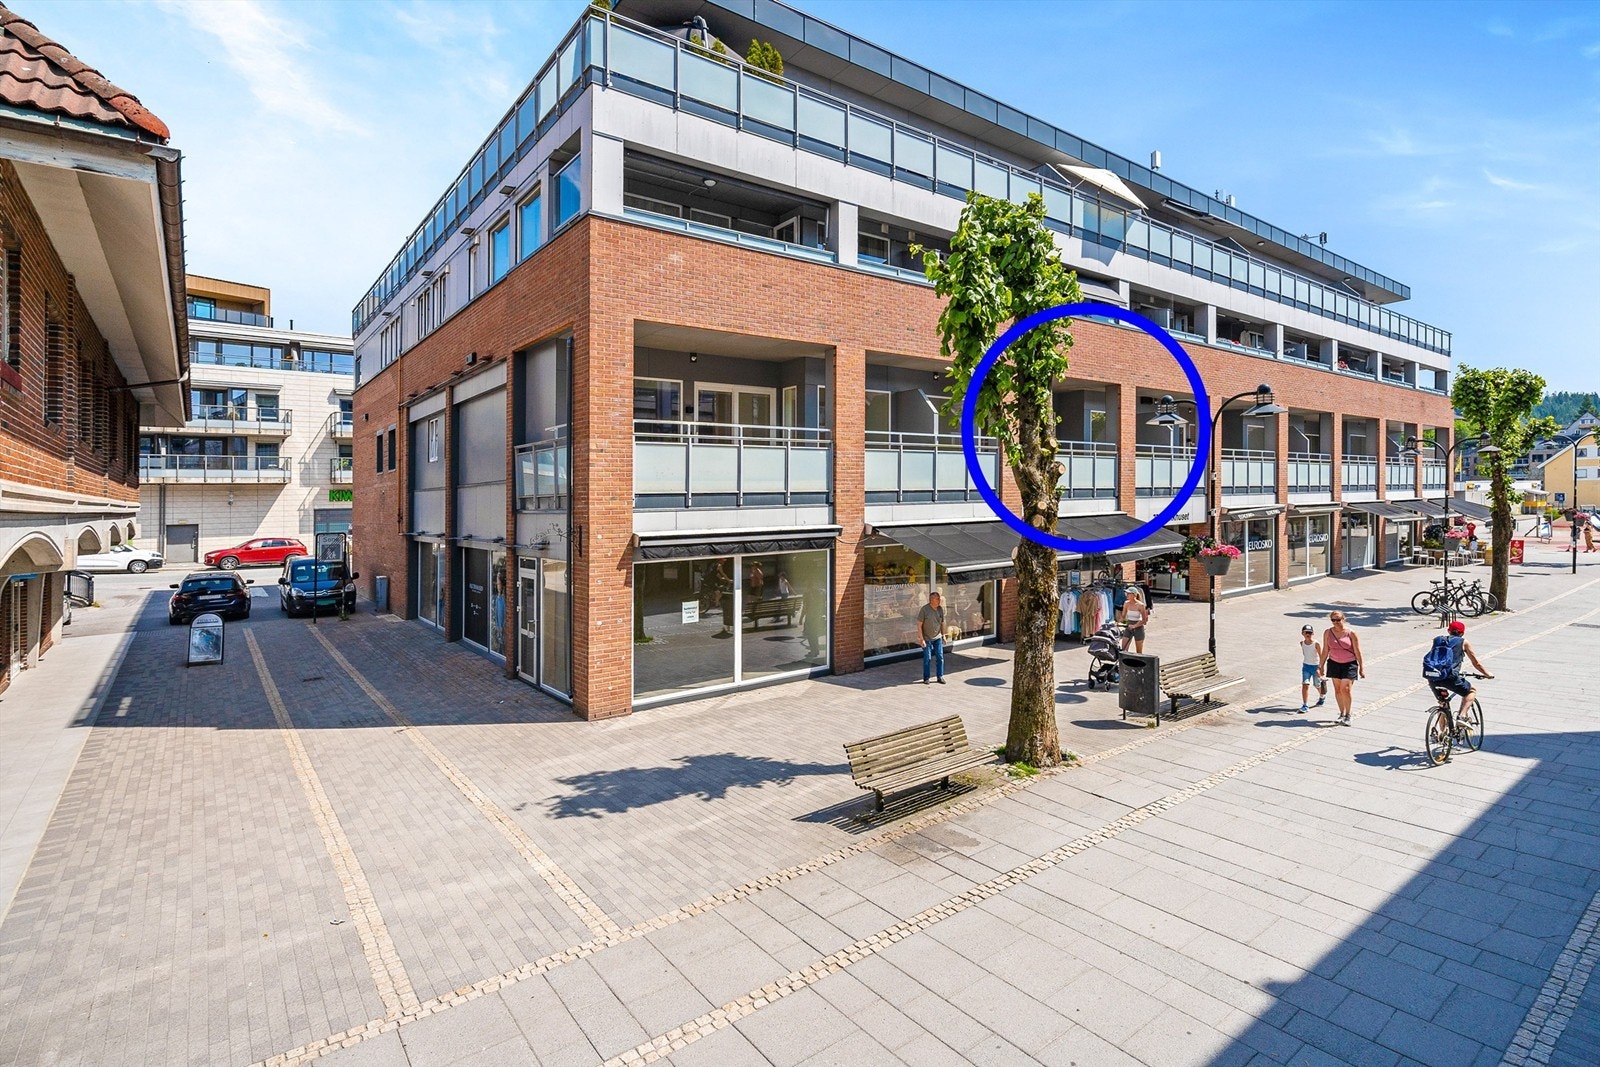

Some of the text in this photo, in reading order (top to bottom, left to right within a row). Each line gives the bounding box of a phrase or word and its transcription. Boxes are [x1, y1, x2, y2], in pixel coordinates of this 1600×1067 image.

[329, 490, 353, 502] KIW
[1309, 533, 1329, 543] EUROSKO
[1248, 539, 1273, 551] EUROSKO
